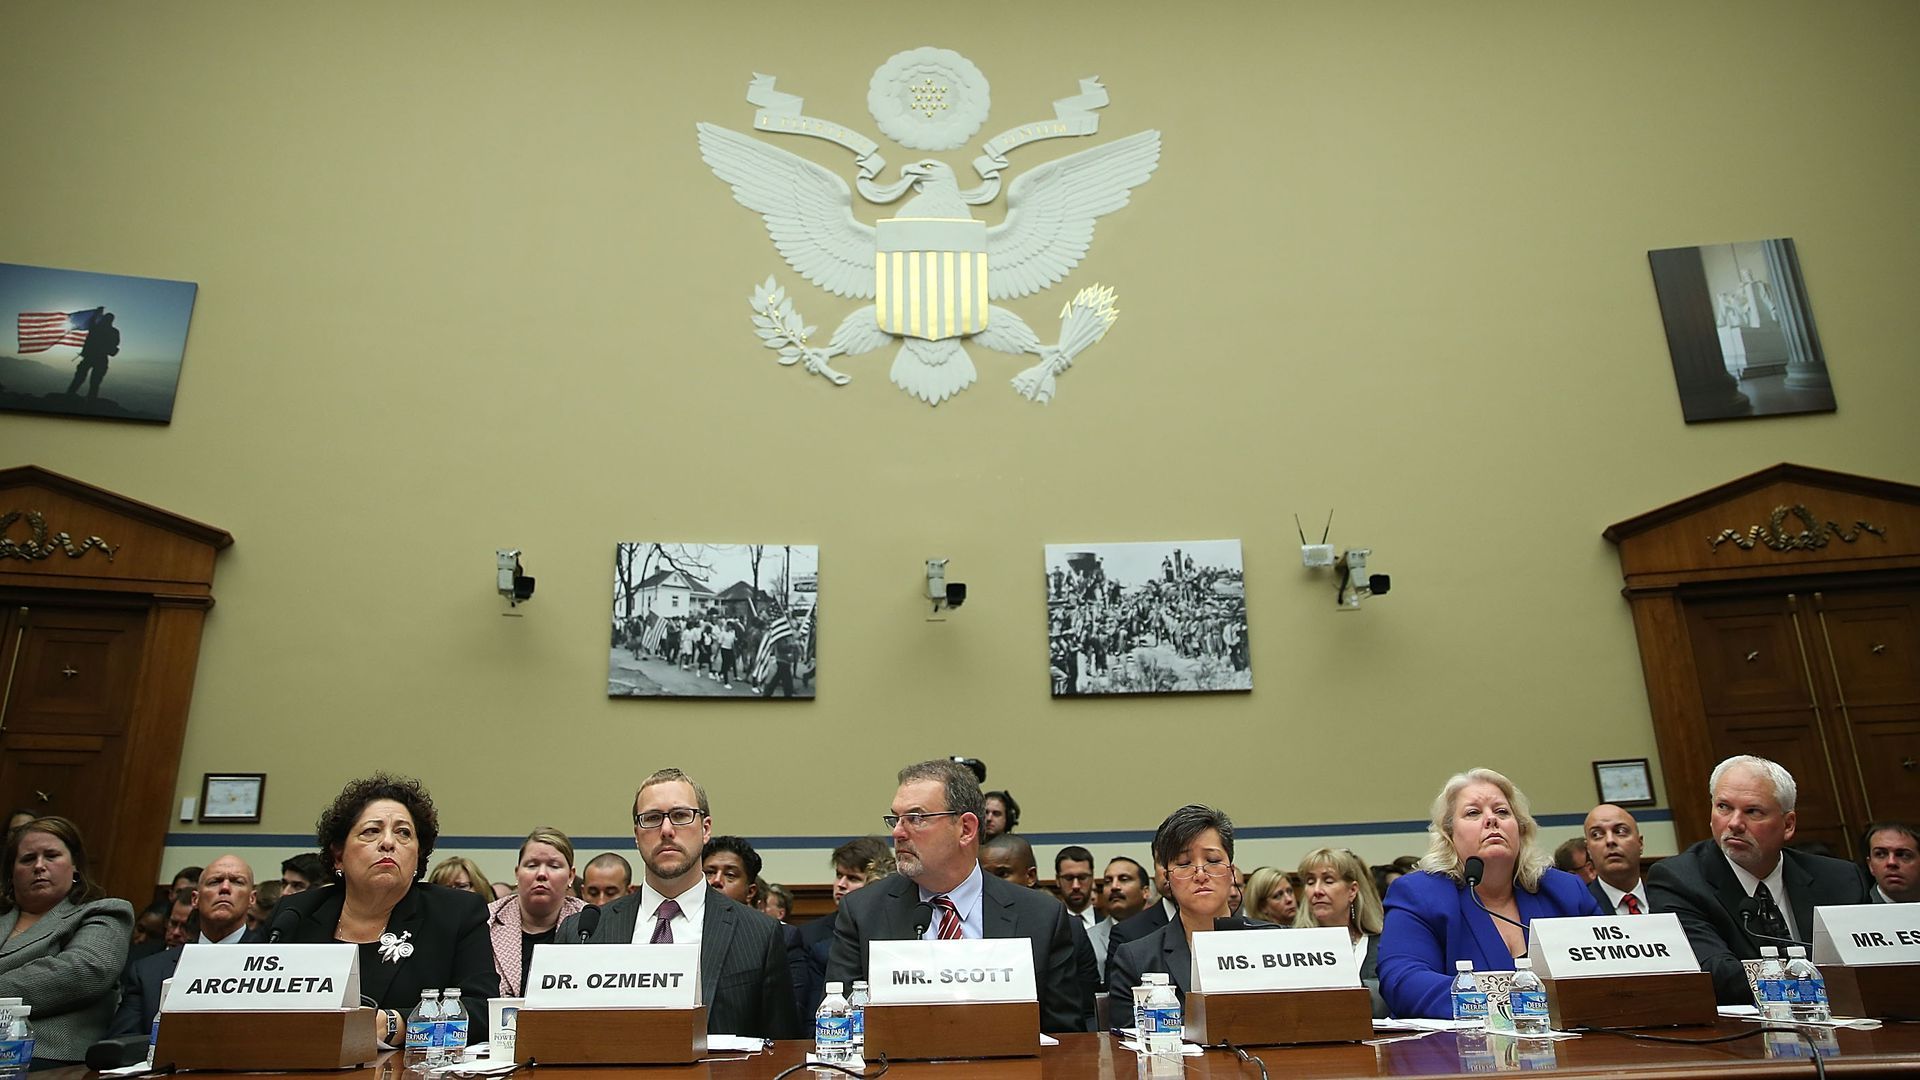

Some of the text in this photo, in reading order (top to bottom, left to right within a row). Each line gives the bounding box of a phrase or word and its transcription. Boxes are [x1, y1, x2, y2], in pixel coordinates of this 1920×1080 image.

[1591, 925, 1631, 941] MS.
[1851, 930, 1920, 948] MR. ES
[1568, 942, 1671, 962] SEYMOUR
[242, 955, 285, 972] MS.
[1216, 951, 1337, 971] MS. BURNS
[540, 972, 684, 990] DR. OZMENT
[892, 967, 1014, 986] MR. SCOTT
[184, 977, 334, 995] ARCHULETA
[1527, 1001, 1541, 1009] DEER
[413, 1032, 429, 1041] PARK
[831, 1027, 846, 1036] PARK
[0, 1050, 16, 1058] ARK
